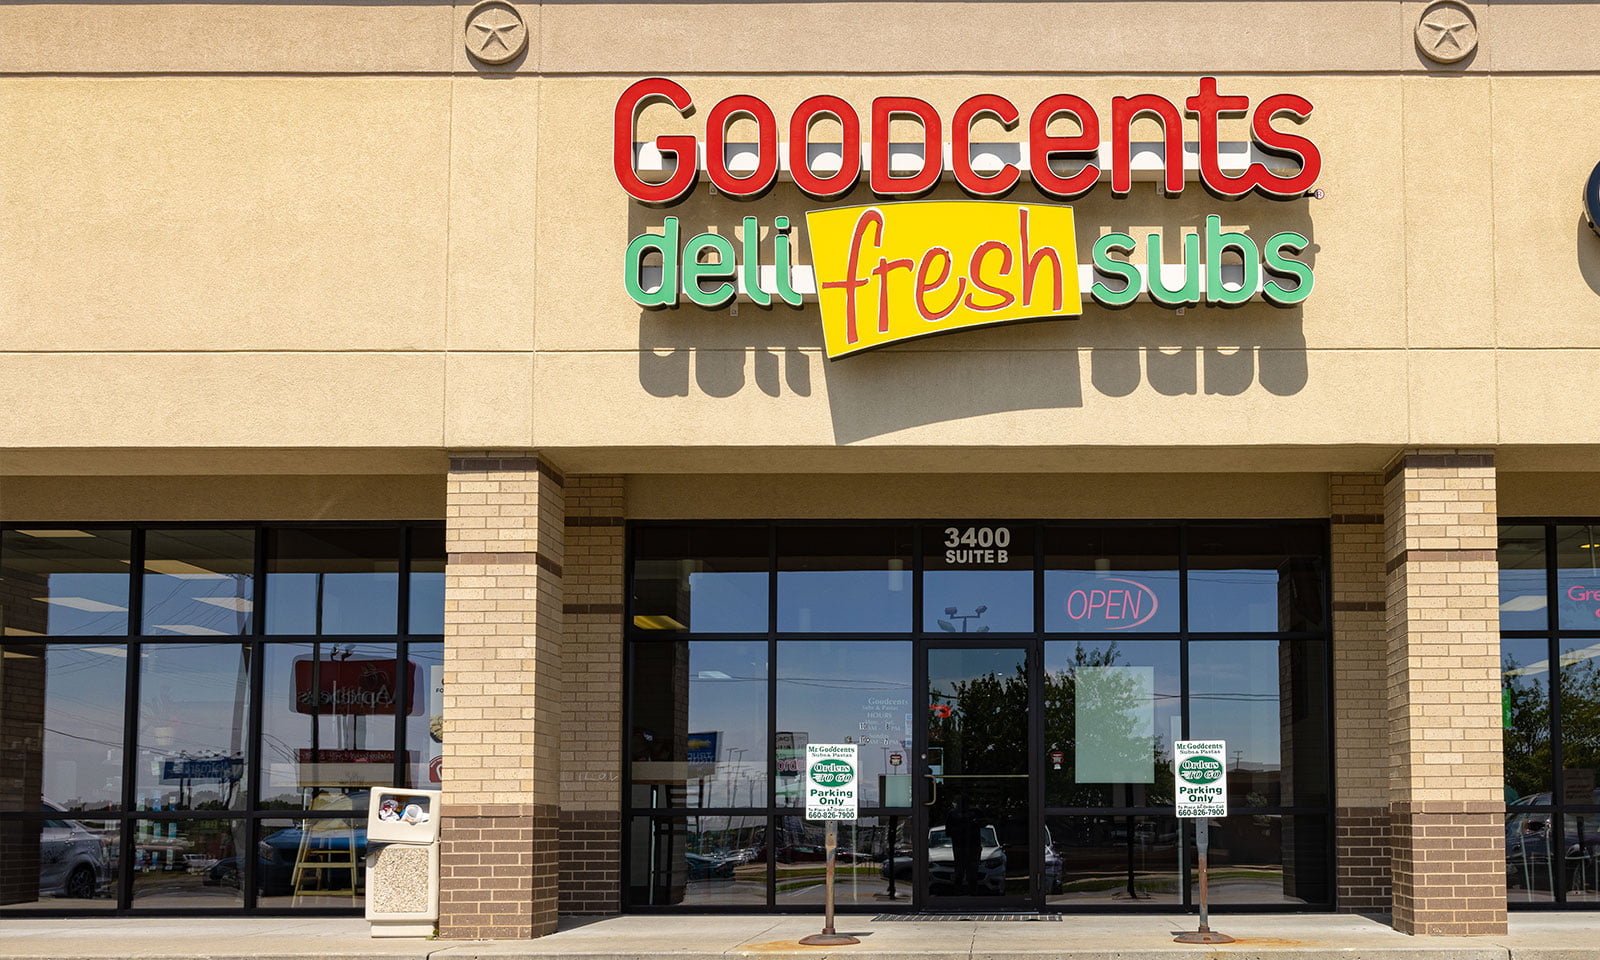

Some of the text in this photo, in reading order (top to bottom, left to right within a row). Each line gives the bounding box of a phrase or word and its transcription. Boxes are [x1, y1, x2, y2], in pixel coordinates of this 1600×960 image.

[624, 208, 1316, 344] deli fresh subs
[944, 527, 1010, 548] 3400
[945, 549, 1009, 564] SUITE B
[1067, 589, 1142, 620] OPEN
[814, 763, 850, 772] Orders
[1183, 760, 1219, 769] Orders
[835, 774, 853, 783] GO
[1203, 770, 1221, 779] GO
[810, 789, 853, 798] Parking
[1179, 786, 1223, 795] Parking
[819, 797, 844, 806] Only
[1188, 794, 1214, 803] Only
